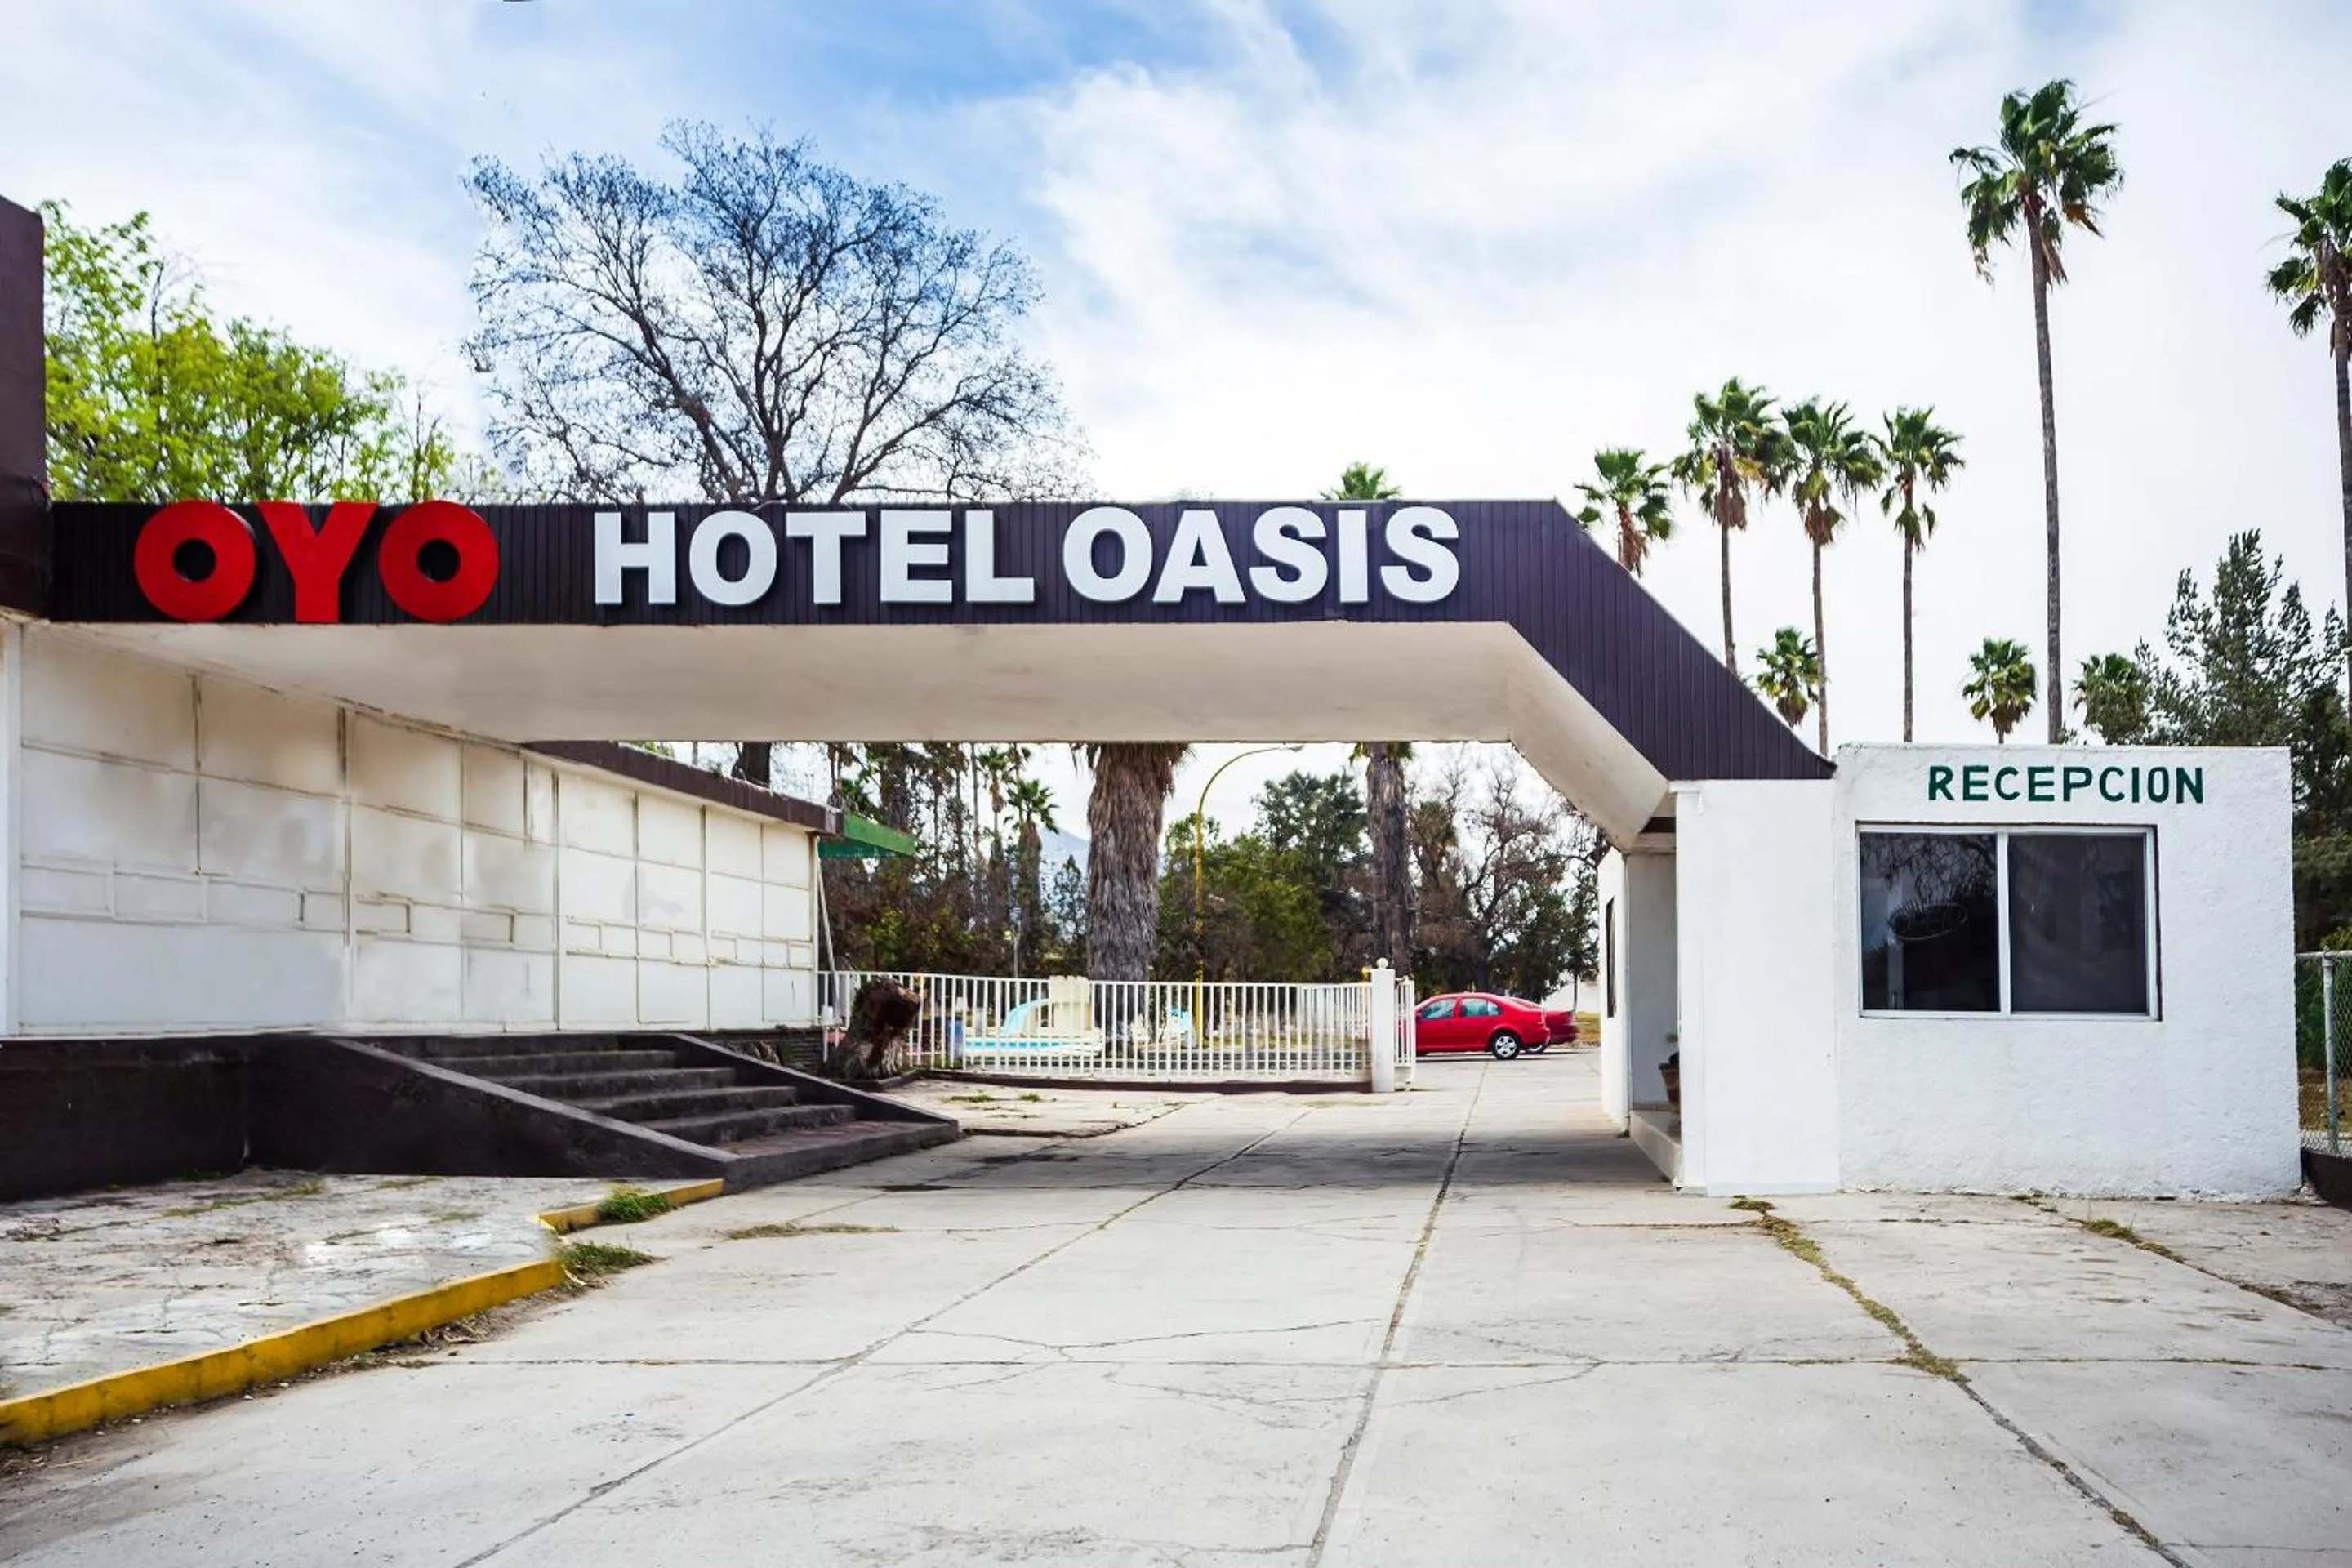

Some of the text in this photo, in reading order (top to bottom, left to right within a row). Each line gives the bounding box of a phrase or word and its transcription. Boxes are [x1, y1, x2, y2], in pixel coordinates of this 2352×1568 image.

[134, 499, 1461, 622] OYO HOTEL OASIS
[1927, 764, 2205, 804] RECEPCION
